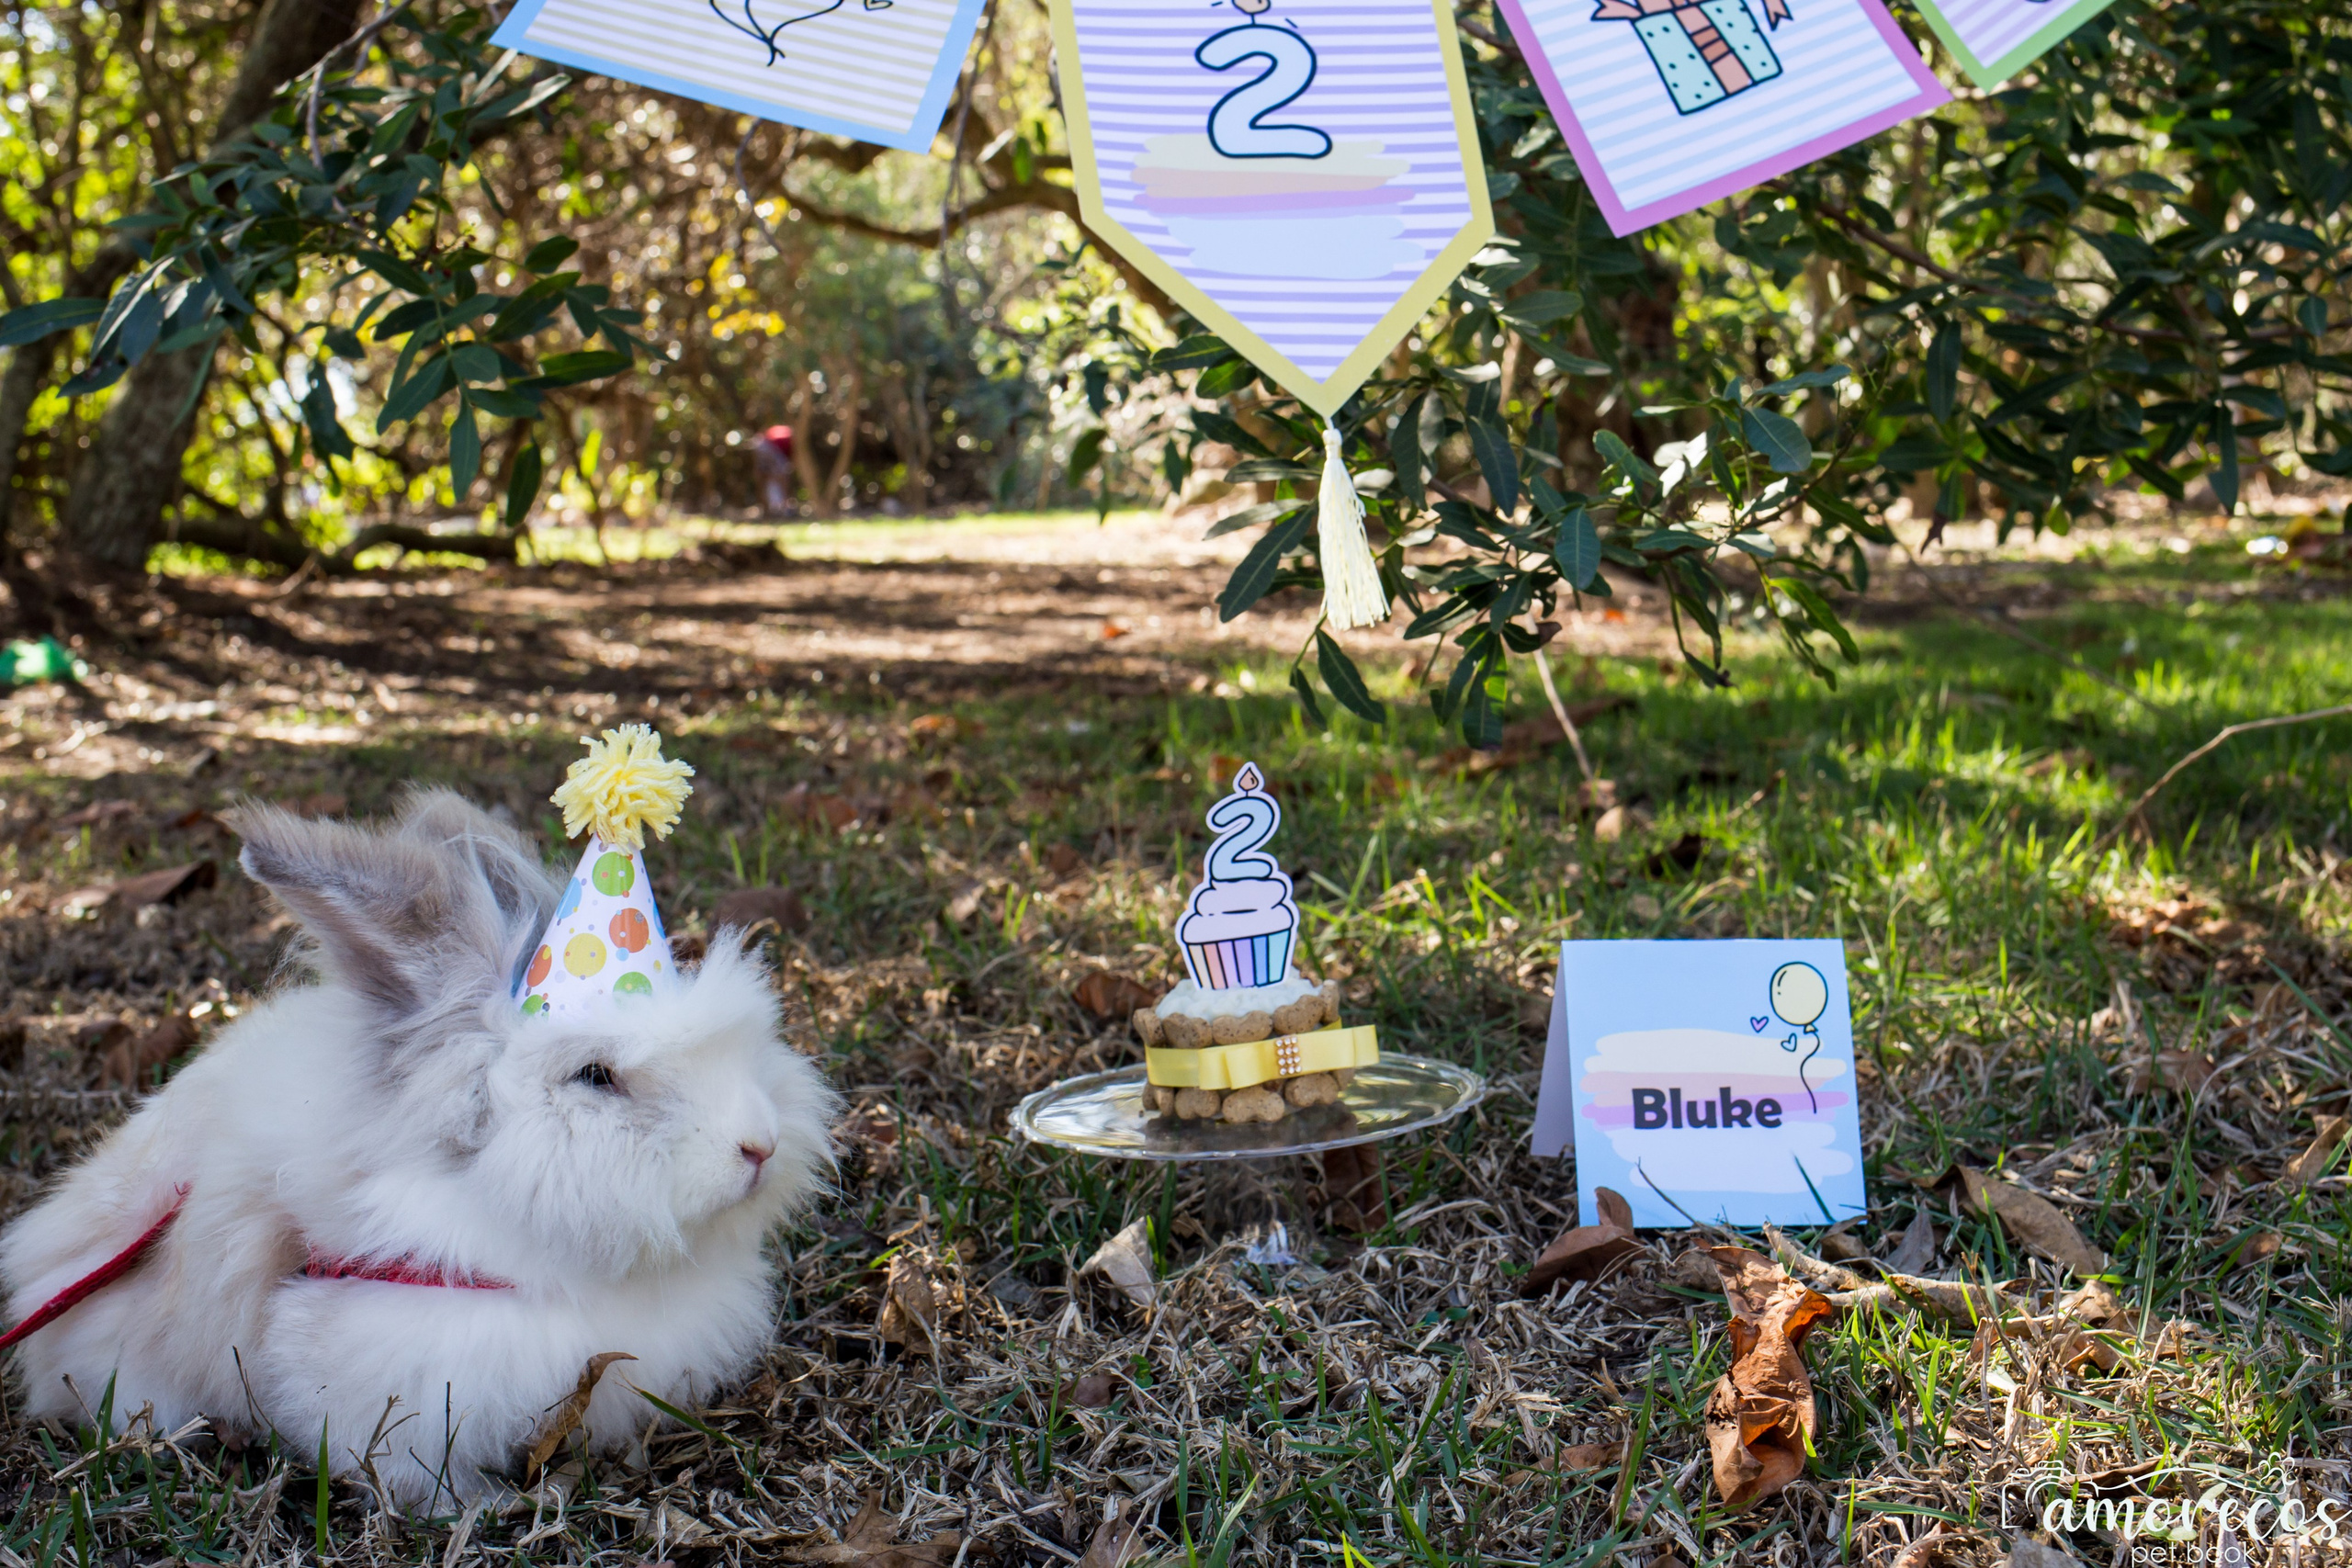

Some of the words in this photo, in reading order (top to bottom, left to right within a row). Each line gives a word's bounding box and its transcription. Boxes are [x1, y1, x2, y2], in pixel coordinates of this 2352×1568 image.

[1195, 23, 1332, 159] 2
[1210, 795, 1275, 882] 2
[1632, 1087, 1782, 1130] Bluke
